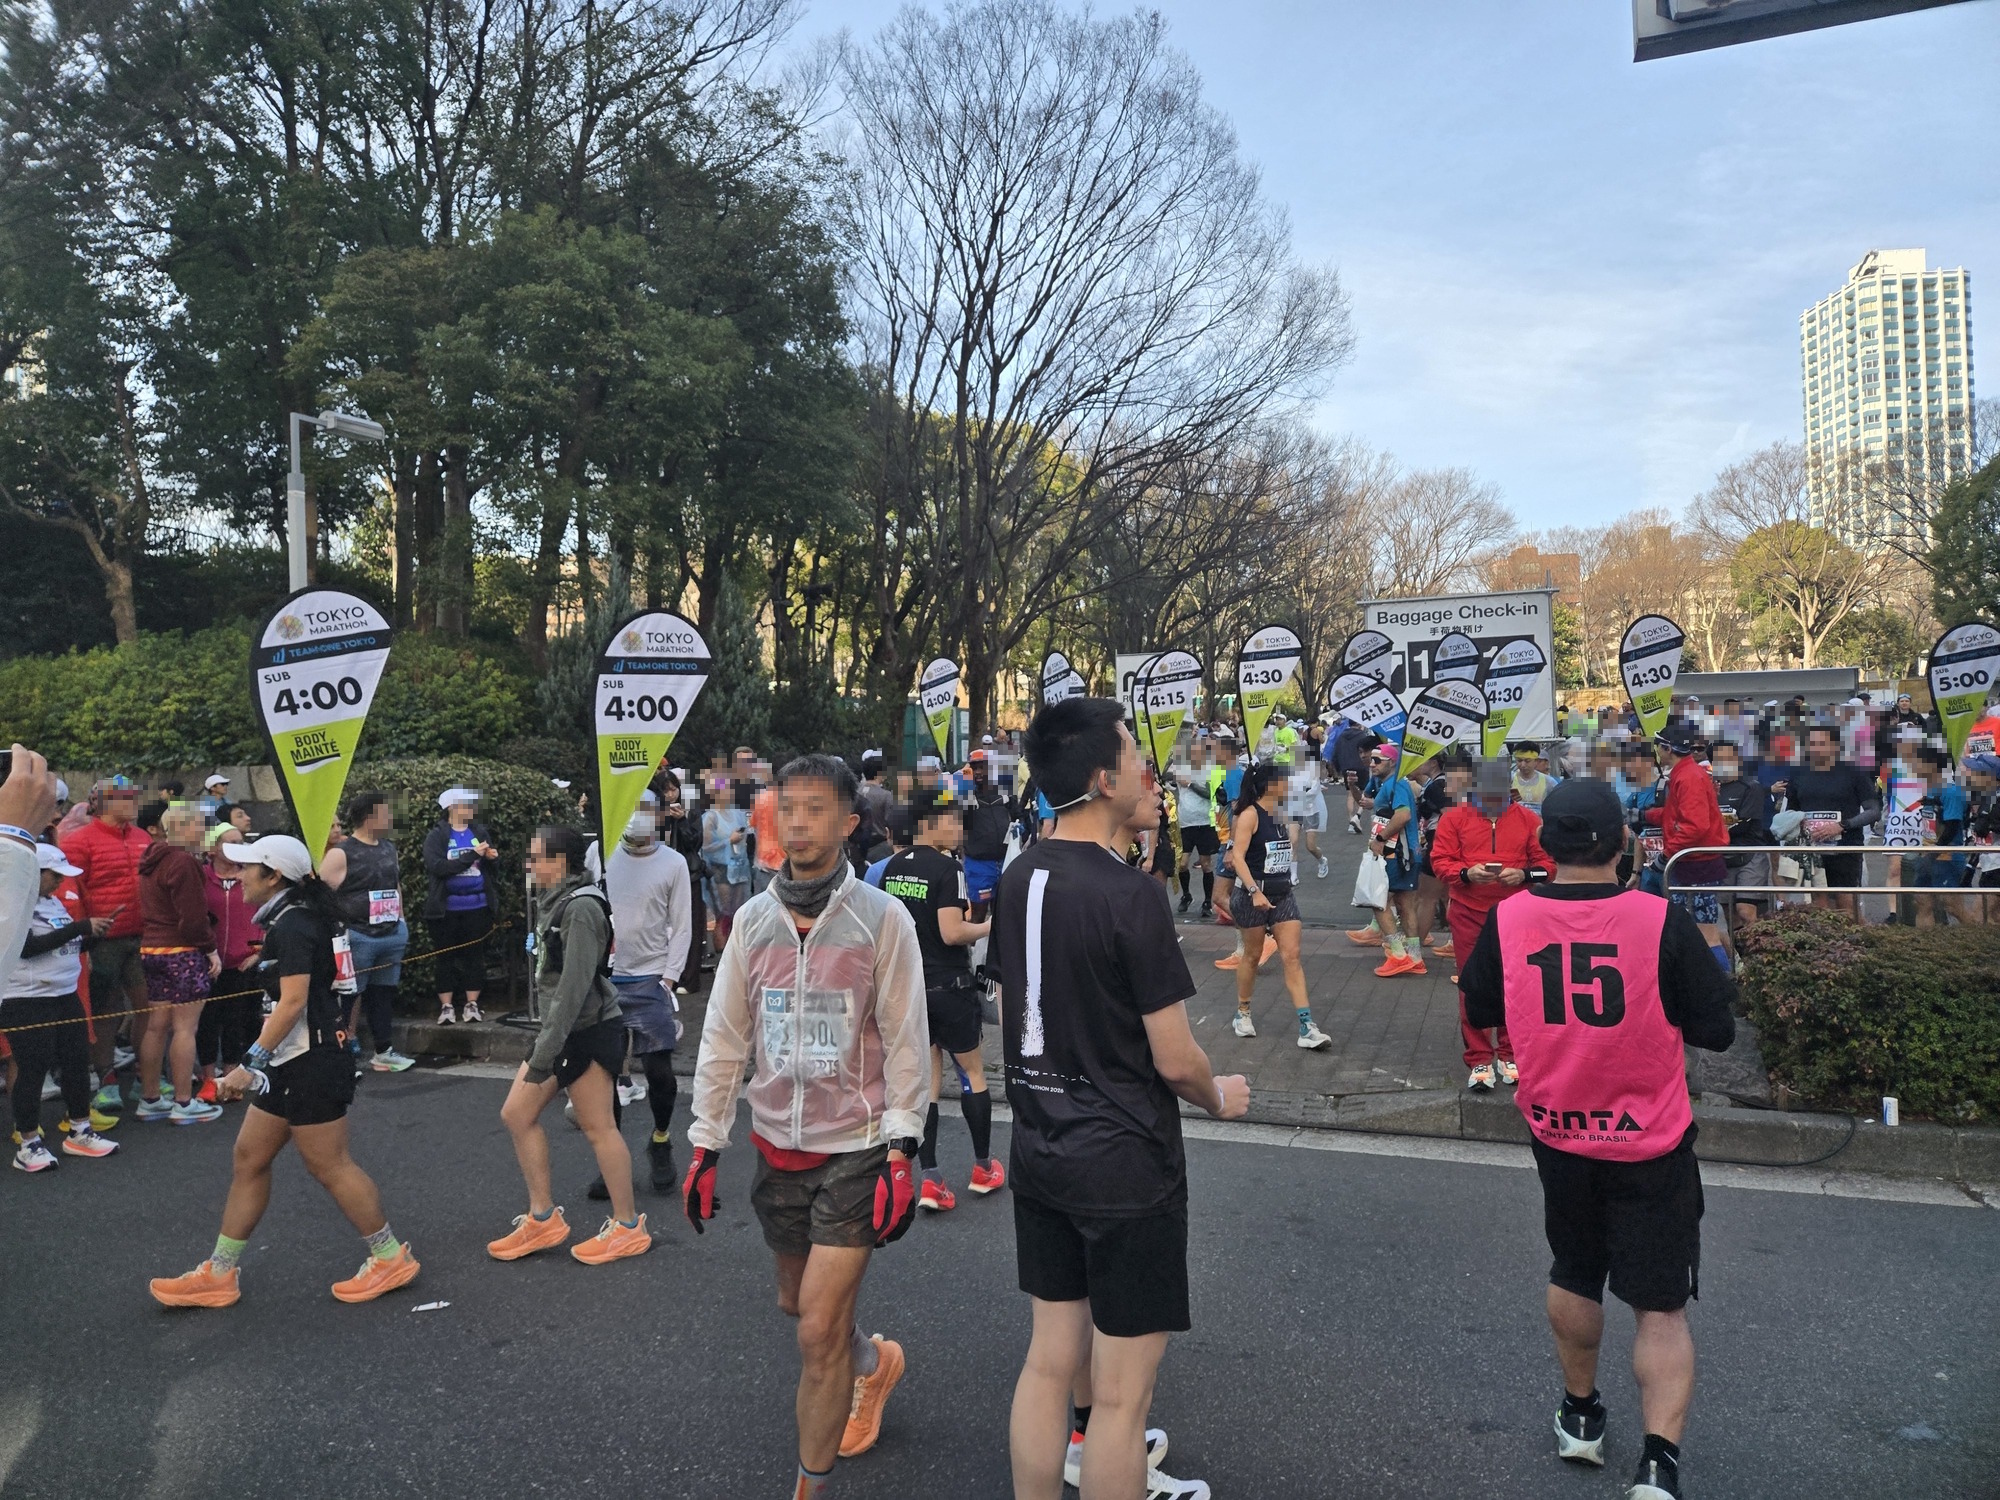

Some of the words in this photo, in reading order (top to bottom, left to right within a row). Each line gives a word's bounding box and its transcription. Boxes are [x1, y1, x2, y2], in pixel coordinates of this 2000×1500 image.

[304, 606, 364, 625] TOKYO
[1377, 609, 1453, 626] Baggage
[1459, 602, 1538, 619] Check-in
[309, 620, 368, 635] MARATHON
[1430, 624, 1483, 636] 手荷物預け
[1642, 625, 1670, 638] TOKYO
[342, 636, 376, 648] TOKYO
[646, 632, 694, 644] TOKYO
[1265, 636, 1291, 644] TOKYO
[1357, 636, 1379, 650] TOKYO
[1644, 633, 1671, 644] MARATHON
[1959, 631, 1993, 643] TOKYO
[1448, 642, 1469, 652] TOKYO
[1509, 649, 1534, 660] TOKYO
[627, 662, 650, 670] TEAM
[651, 662, 669, 670] ONE
[670, 662, 698, 671] TOKYO
[1169, 659, 1192, 668] TOKYO
[1413, 650, 1429, 679] 1
[1626, 663, 1638, 672] SUB
[264, 671, 291, 684] SUB
[1242, 669, 1283, 685] 4:30
[1632, 664, 1672, 688] 4:30
[1935, 667, 1949, 675] SUB
[603, 680, 624, 689] SUB
[1343, 678, 1365, 691] TOKYO
[1939, 669, 1989, 692] 5:00
[273, 676, 363, 716] 4:00
[926, 691, 951, 708] 4:00
[1150, 691, 1186, 708] 4:15
[1452, 689, 1481, 705] TOKYO
[1487, 686, 1523, 704] 4:30
[604, 695, 678, 722] 4:00
[1361, 698, 1394, 722] 4:15
[1416, 706, 1429, 714] SUB
[1449, 696, 1478, 710] MARATHON
[1411, 715, 1455, 739] 4:30
[294, 731, 327, 747] BODY
[615, 739, 641, 751] BODY
[290, 739, 340, 762] MAINTÉ
[609, 748, 648, 762] MAINTÉ
[1889, 815, 1922, 828] OKY
[1886, 828, 1925, 836] ARATH
[1272, 851, 1290, 863] 33712
[886, 881, 928, 899] FINISHER
[1526, 942, 1626, 1028] 15
[1531, 1104, 1644, 1131] FINTA
[1541, 1129, 1570, 1139] FINTA
[1589, 1134, 1632, 1142] BRASIL
